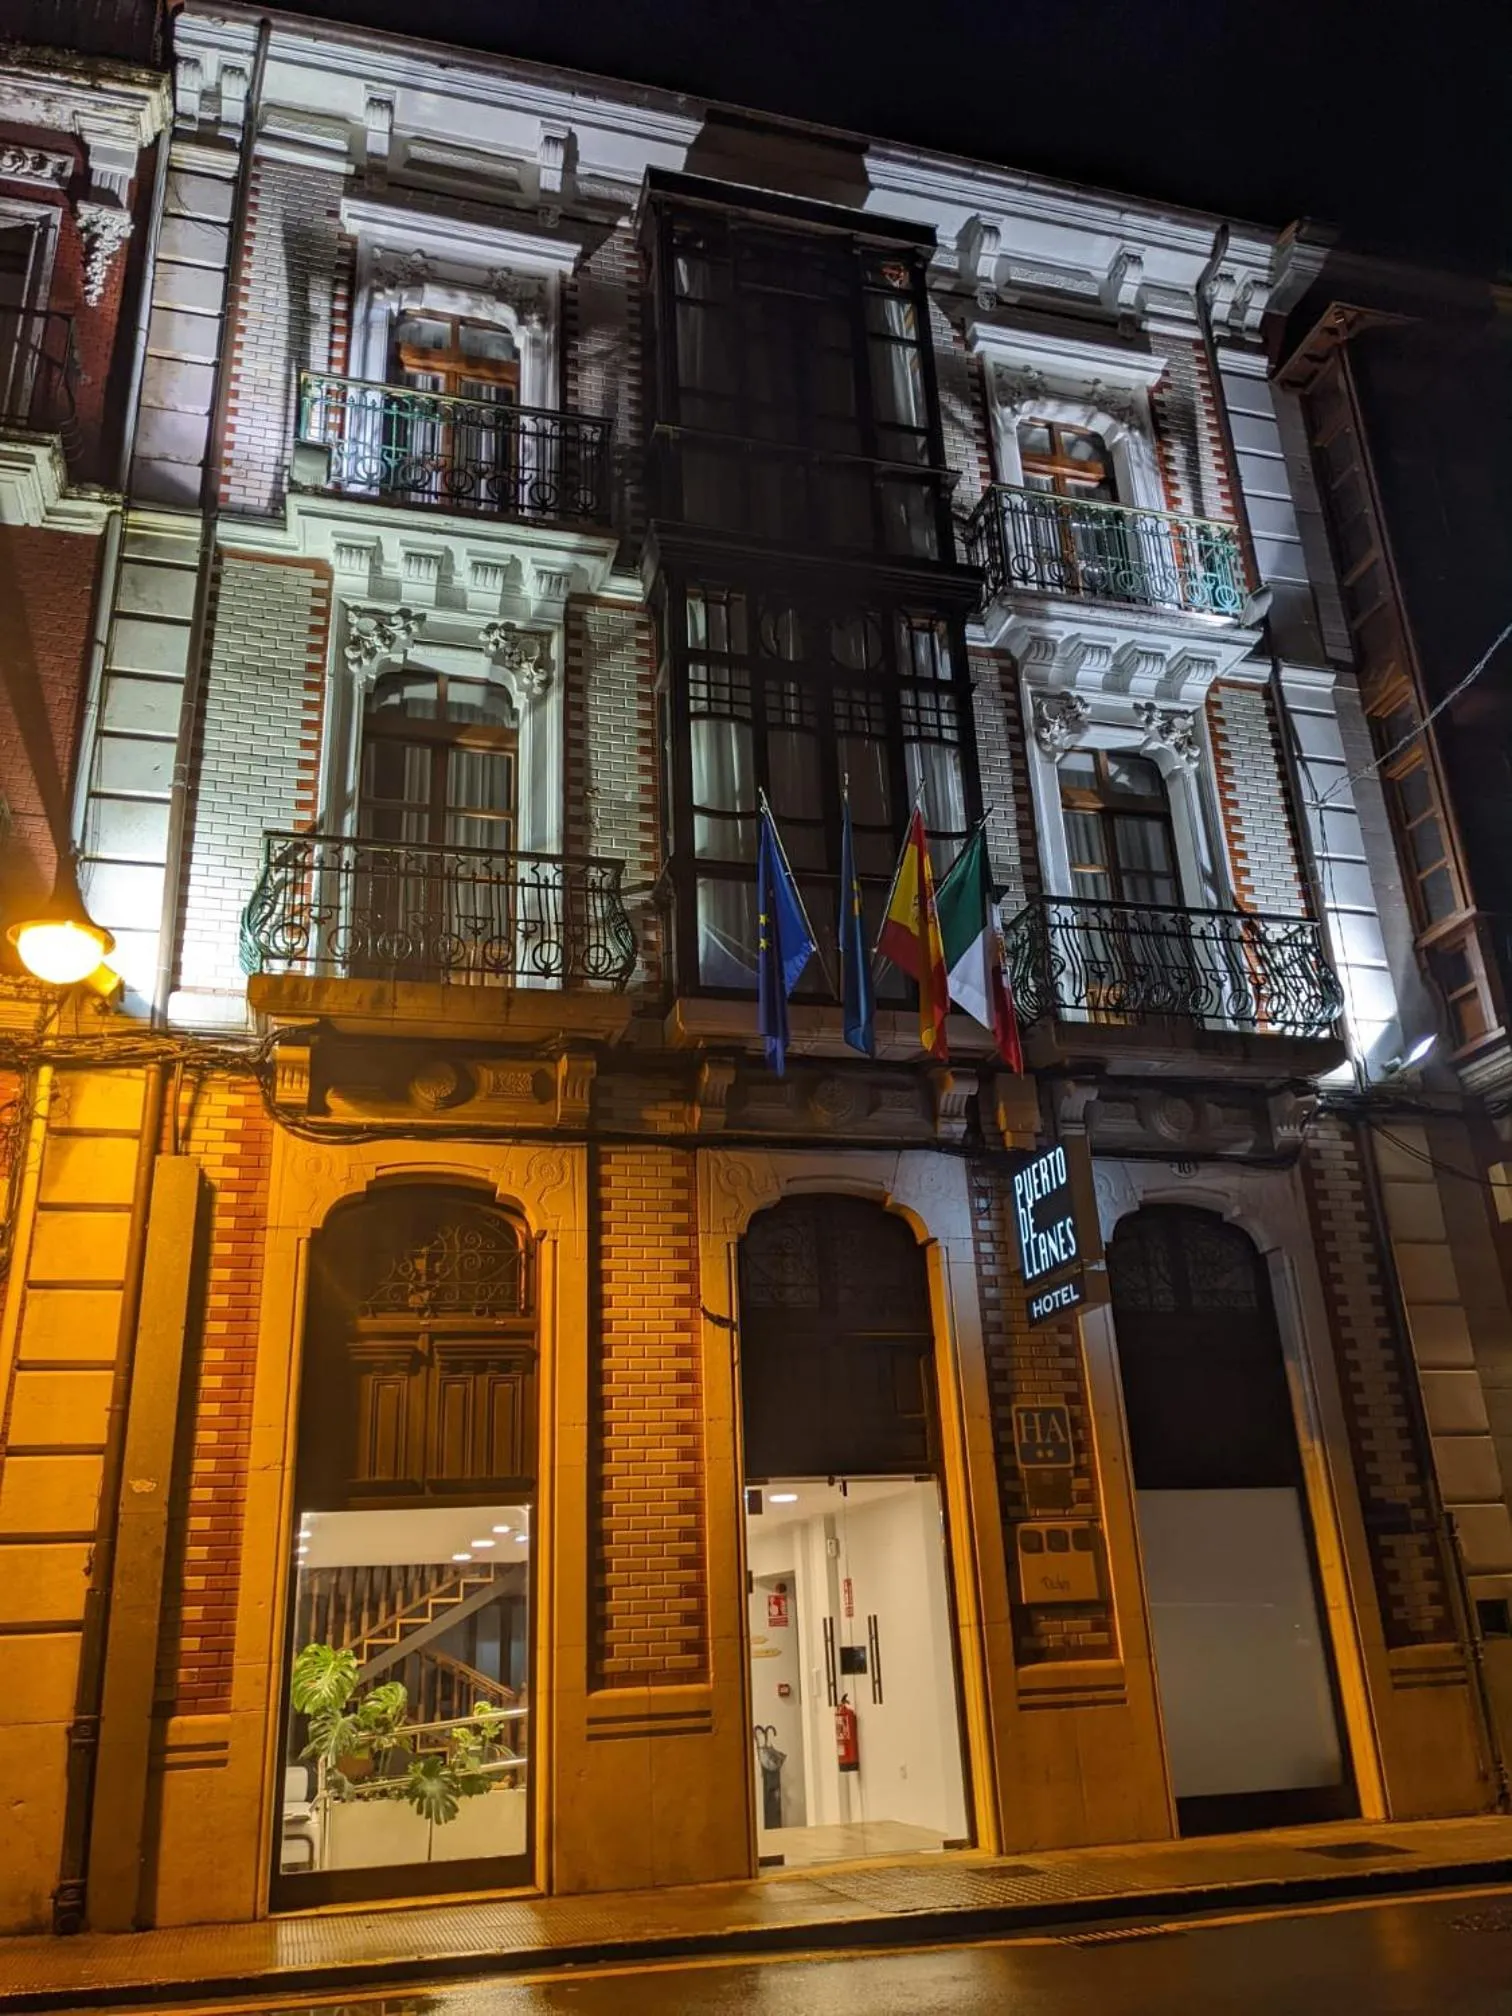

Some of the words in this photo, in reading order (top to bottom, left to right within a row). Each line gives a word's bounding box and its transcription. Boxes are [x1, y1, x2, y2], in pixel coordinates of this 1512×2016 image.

[1014, 1146, 1067, 1205] PUERTO
[1018, 1204, 1037, 1243] DE
[1022, 1216, 1076, 1279] LLANES
[1032, 1284, 1080, 1318] HOTEL
[1019, 1412, 1065, 1443] HA
